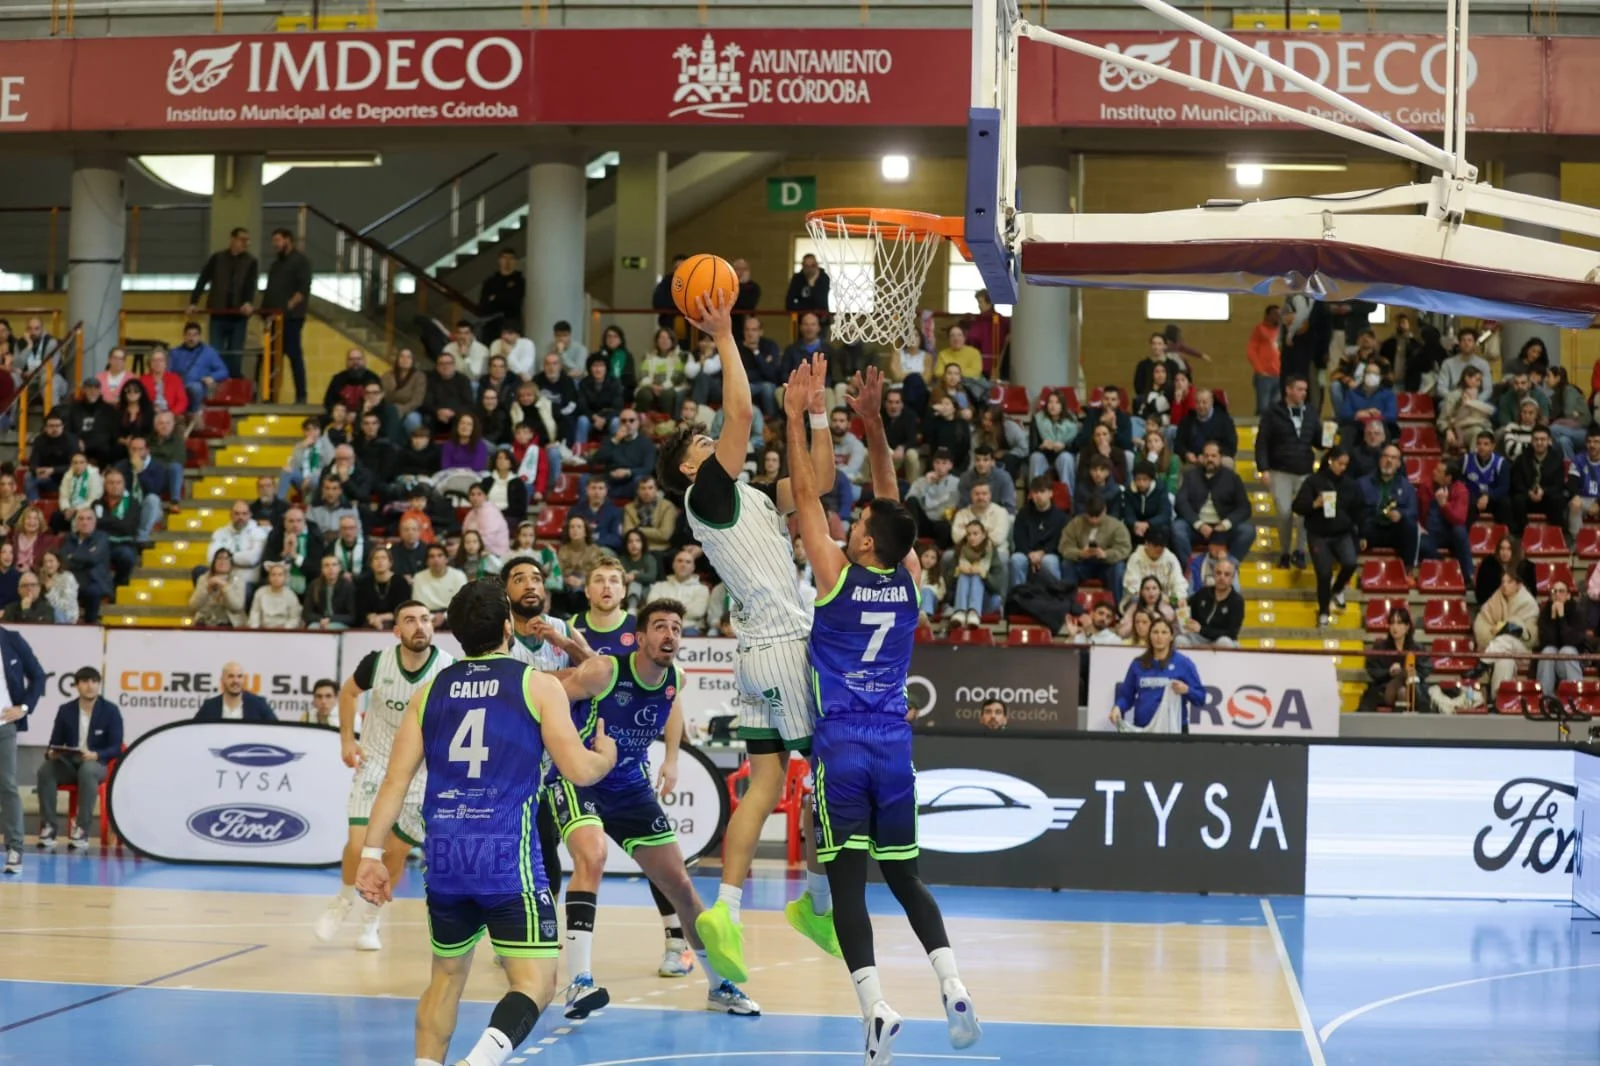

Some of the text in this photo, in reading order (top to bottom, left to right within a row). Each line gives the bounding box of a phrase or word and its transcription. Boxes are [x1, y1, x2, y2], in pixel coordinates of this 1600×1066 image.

[247, 36, 524, 92] IMDECO
[749, 49, 892, 74] AYUNTAMIENTO
[1188, 39, 1479, 95] IMDECO
[749, 74, 870, 104] DE CÓRDOBA
[166, 101, 519, 124] Instituto Municipal de Deportes Córdoba
[1100, 103, 1176, 121] Instituto
[1396, 105, 1476, 124] Córda
[781, 182, 802, 206] D
[860, 611, 896, 662] 7
[676, 646, 733, 663] Carlos
[120, 671, 262, 693] CO.RE.U
[449, 679, 500, 699] CALVO
[448, 707, 490, 778] 4
[216, 770, 293, 792] TYSA
[210, 808, 285, 839] Ford
[1095, 779, 1289, 851] TYSA
[1473, 777, 1584, 878] Fo
